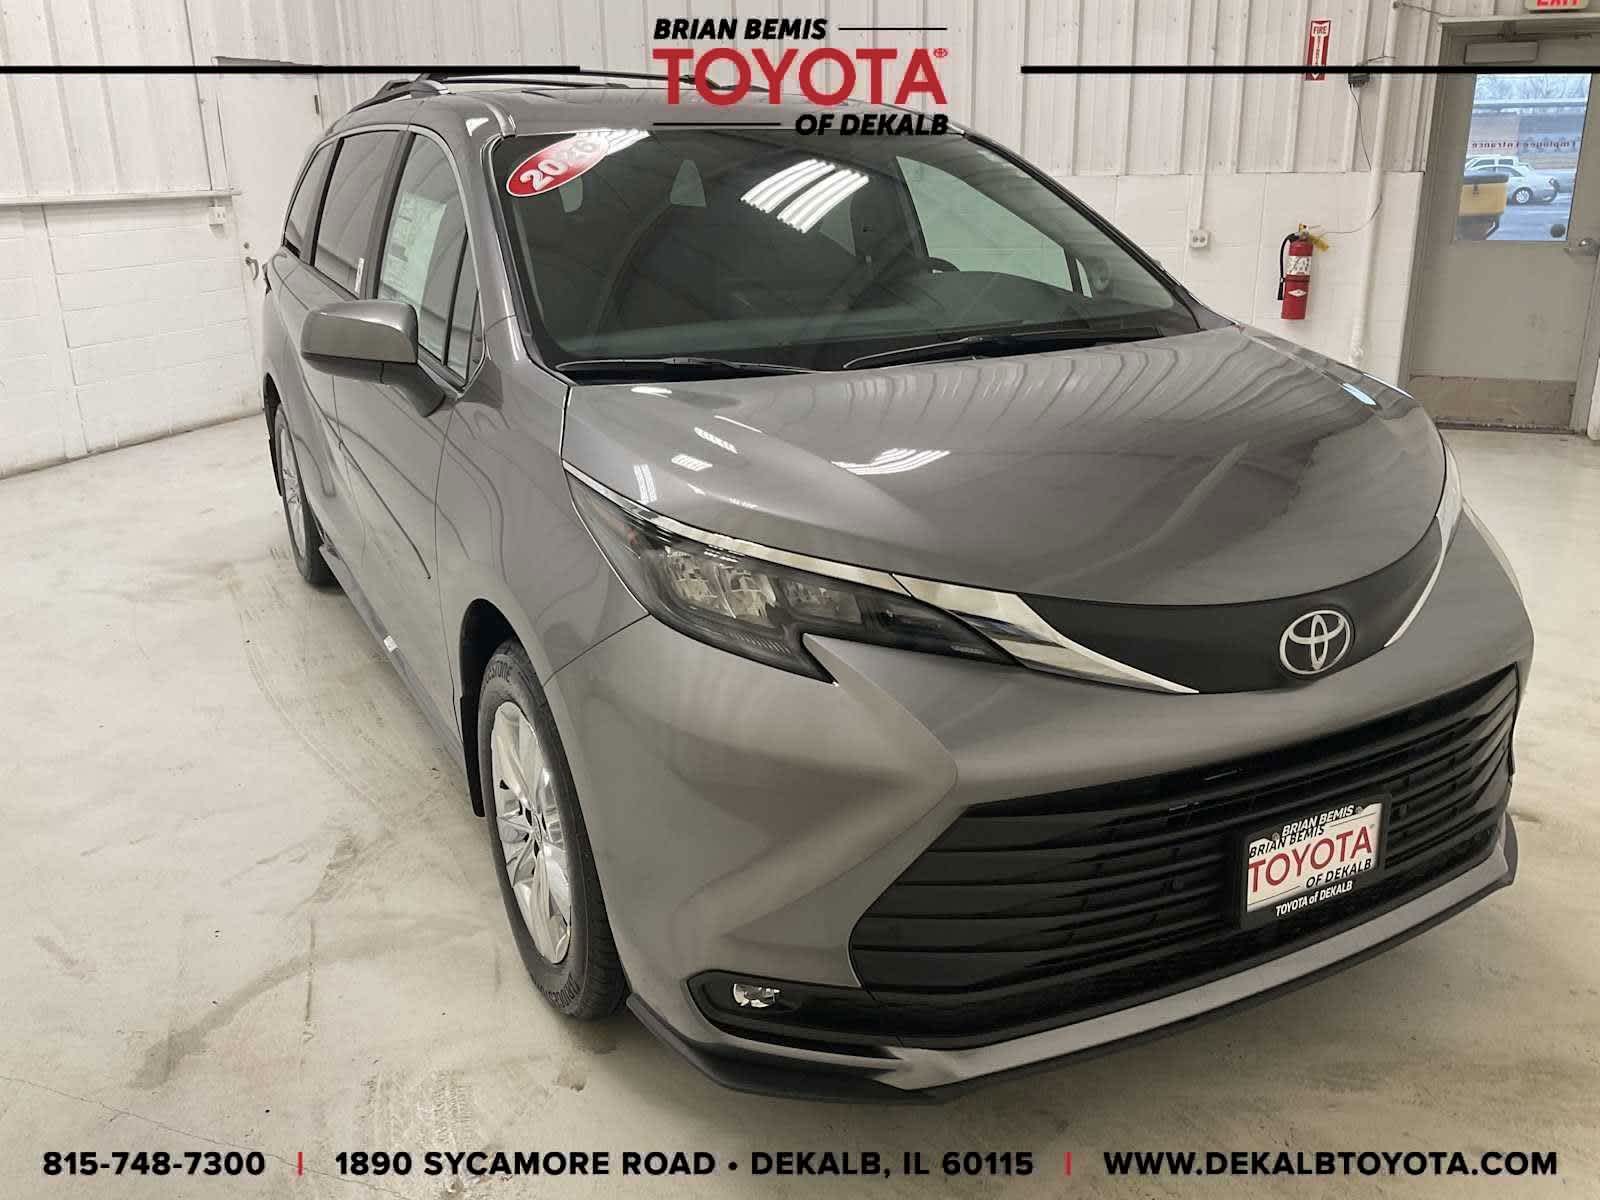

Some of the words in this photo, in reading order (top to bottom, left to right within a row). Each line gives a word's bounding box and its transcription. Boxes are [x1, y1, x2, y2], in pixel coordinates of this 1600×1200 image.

[1282, 816, 1318, 837] BRIAN
[1319, 804, 1355, 825] BEMIS
[1250, 837, 1285, 858] BRIAN
[1289, 825, 1325, 846] BEMIS
[1249, 825, 1372, 893] TOYOTA
[1306, 872, 1323, 889] OF
[1325, 858, 1372, 884] DEKALB
[1275, 895, 1308, 917] TOYOTA
[1309, 893, 1319, 903] of
[1319, 880, 1353, 901] DEKALB
